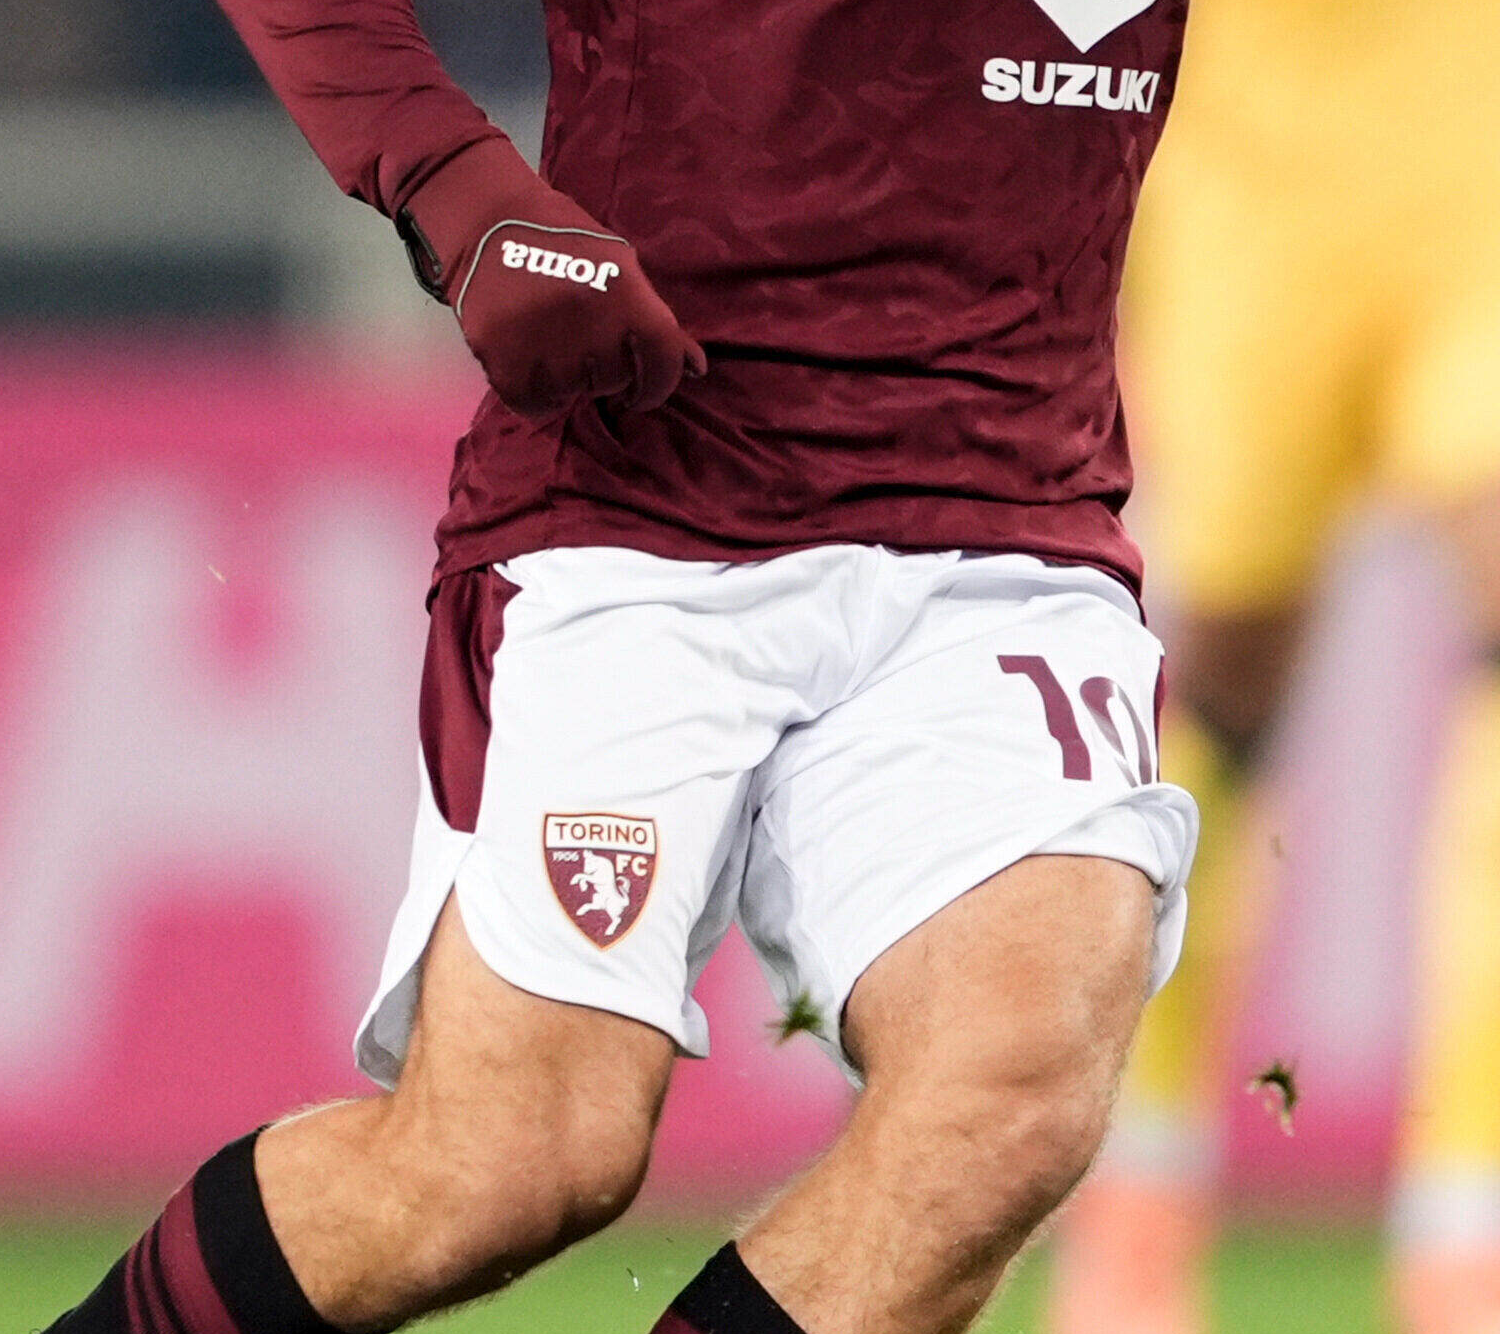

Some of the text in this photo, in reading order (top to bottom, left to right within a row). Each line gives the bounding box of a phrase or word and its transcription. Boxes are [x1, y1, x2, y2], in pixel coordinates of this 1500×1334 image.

[981, 57, 1161, 114] SUZUKI
[996, 654, 1153, 789] 10
[554, 822, 648, 845] TORINO
[615, 853, 649, 877] FC
